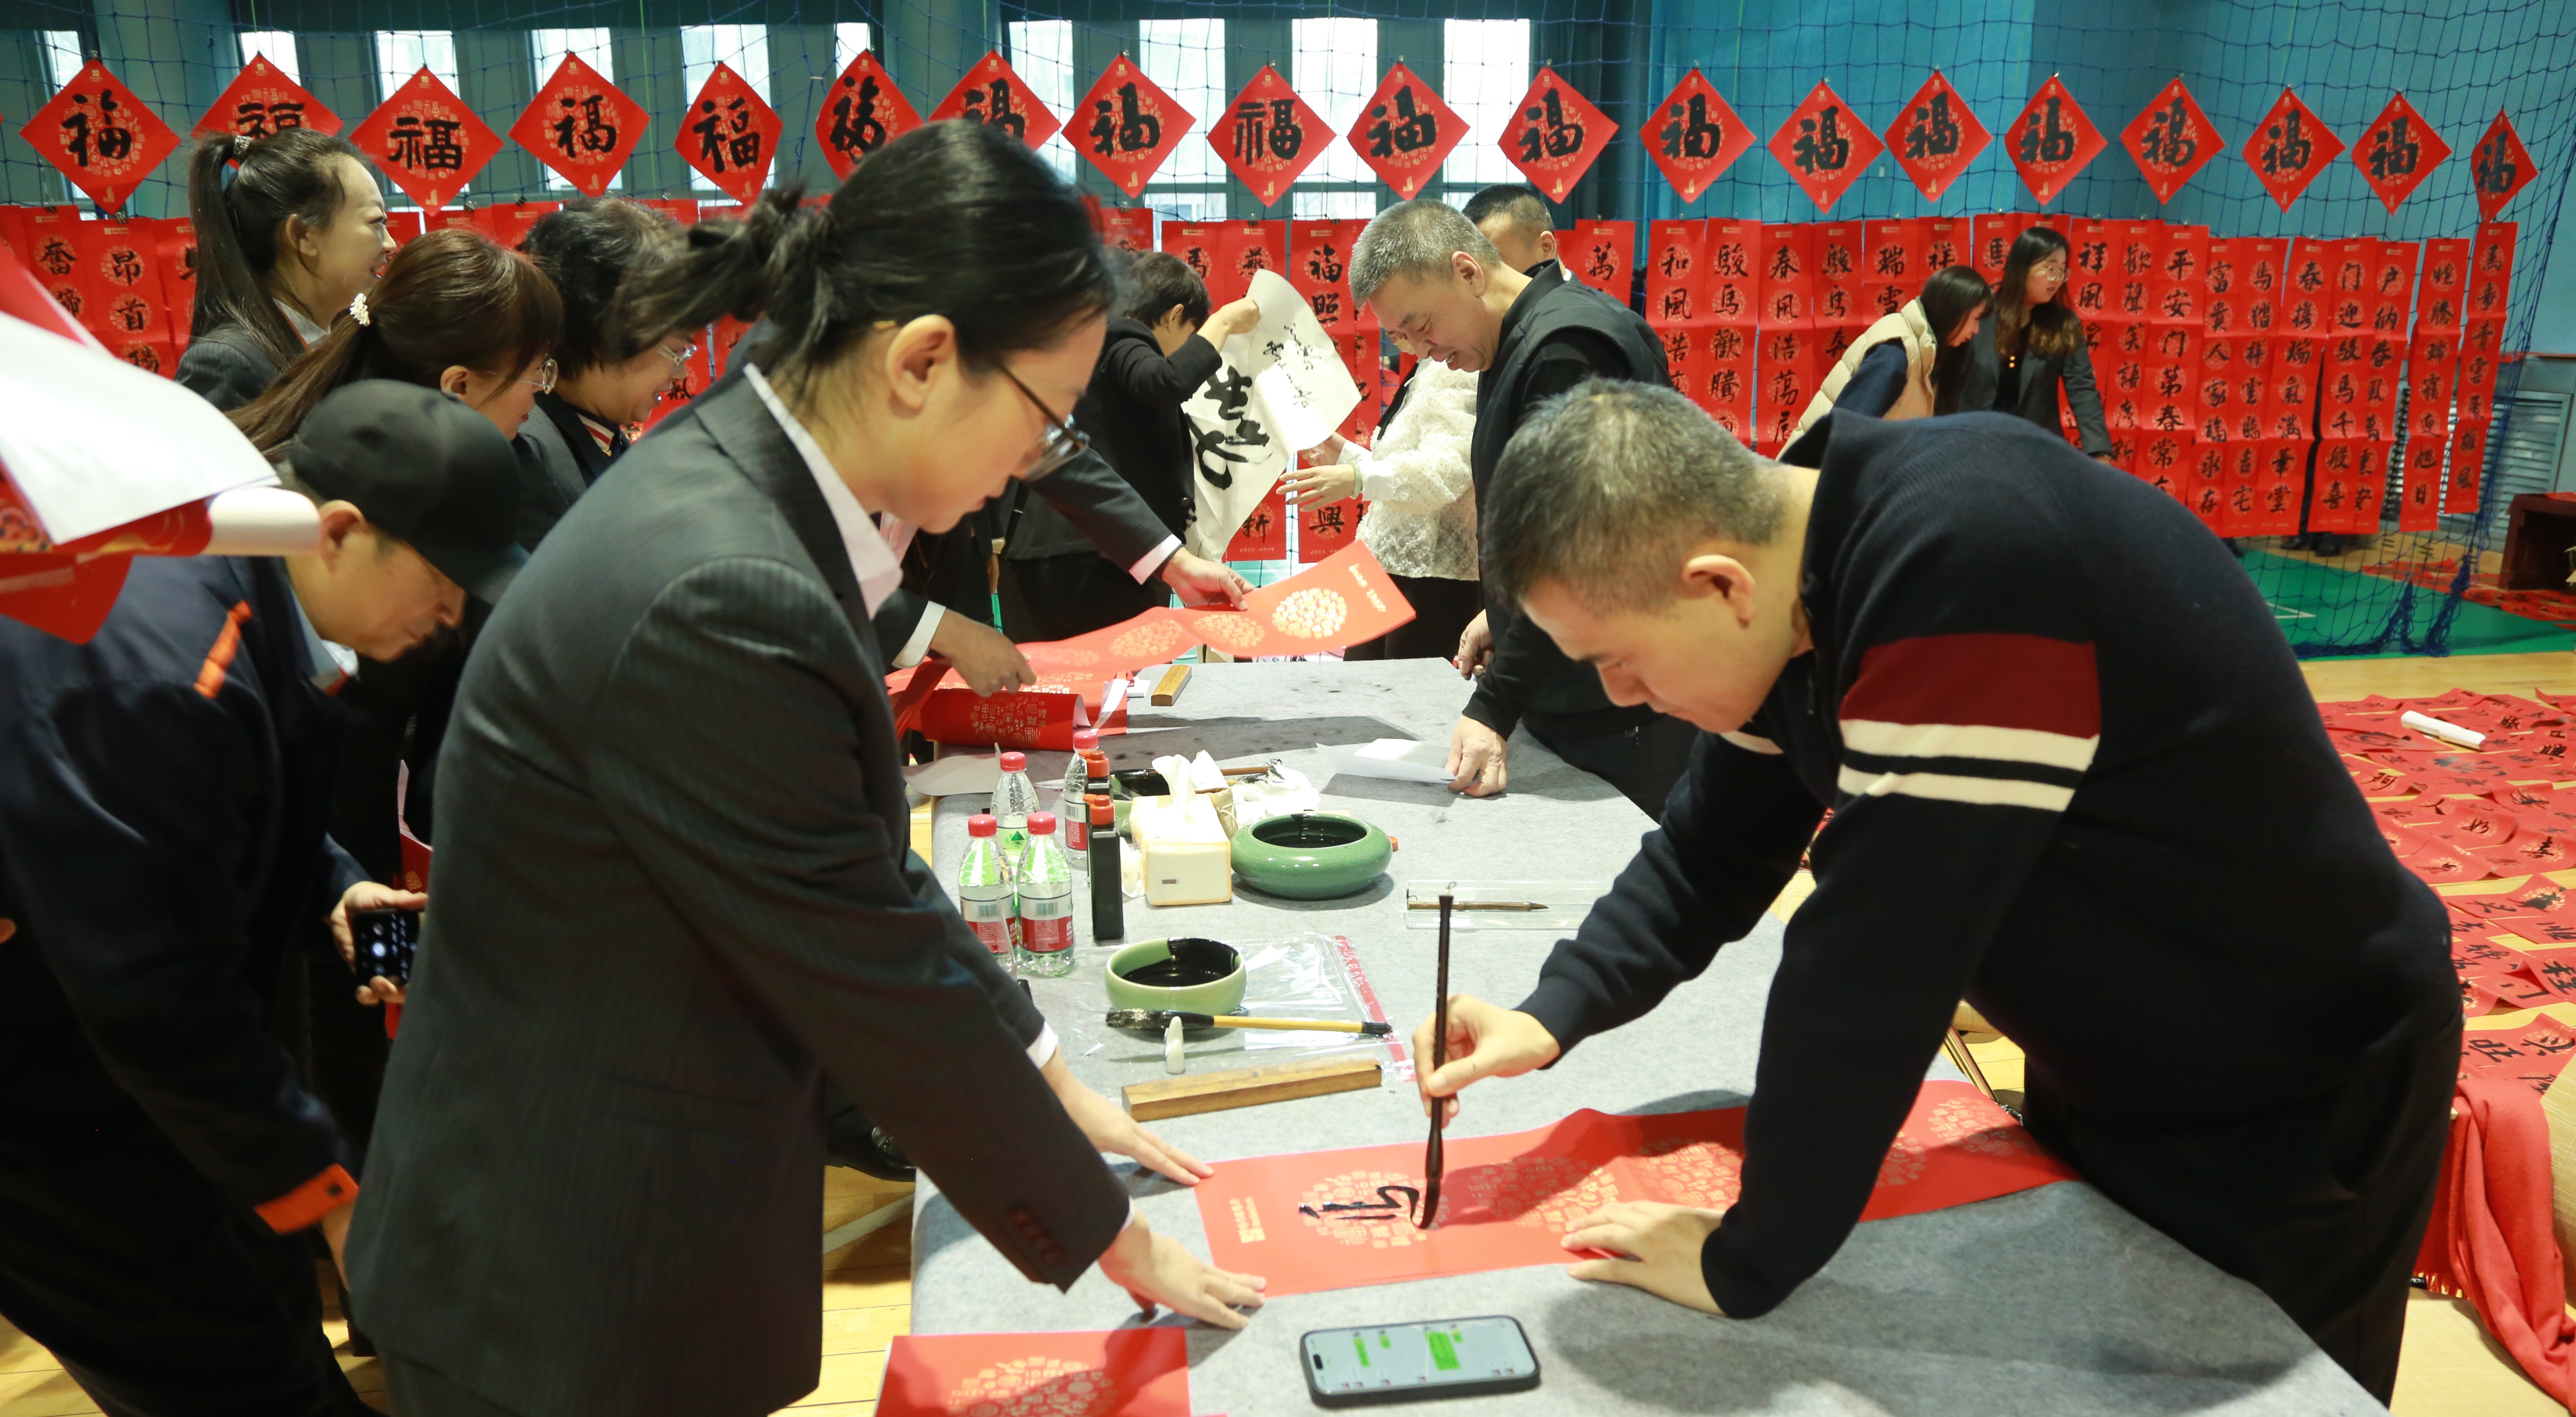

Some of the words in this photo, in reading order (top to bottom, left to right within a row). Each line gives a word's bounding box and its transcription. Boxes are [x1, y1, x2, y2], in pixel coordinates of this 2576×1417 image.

[62, 90, 132, 167] 福
[388, 117, 463, 170] 福
[554, 95, 617, 158] 福
[693, 98, 761, 173] 福
[1090, 82, 1160, 157] 福
[1235, 100, 1302, 165] 福
[1367, 86, 1436, 158] 福
[1518, 88, 1584, 163] 福
[1660, 93, 1720, 159] 福
[1794, 106, 1849, 175] 福
[1906, 91, 1958, 159] 福
[2019, 96, 2074, 164] 福
[2142, 97, 2196, 167] 福
[2261, 109, 2311, 176] 福
[2368, 115, 2419, 181] 福
[2478, 130, 2516, 193] 福
